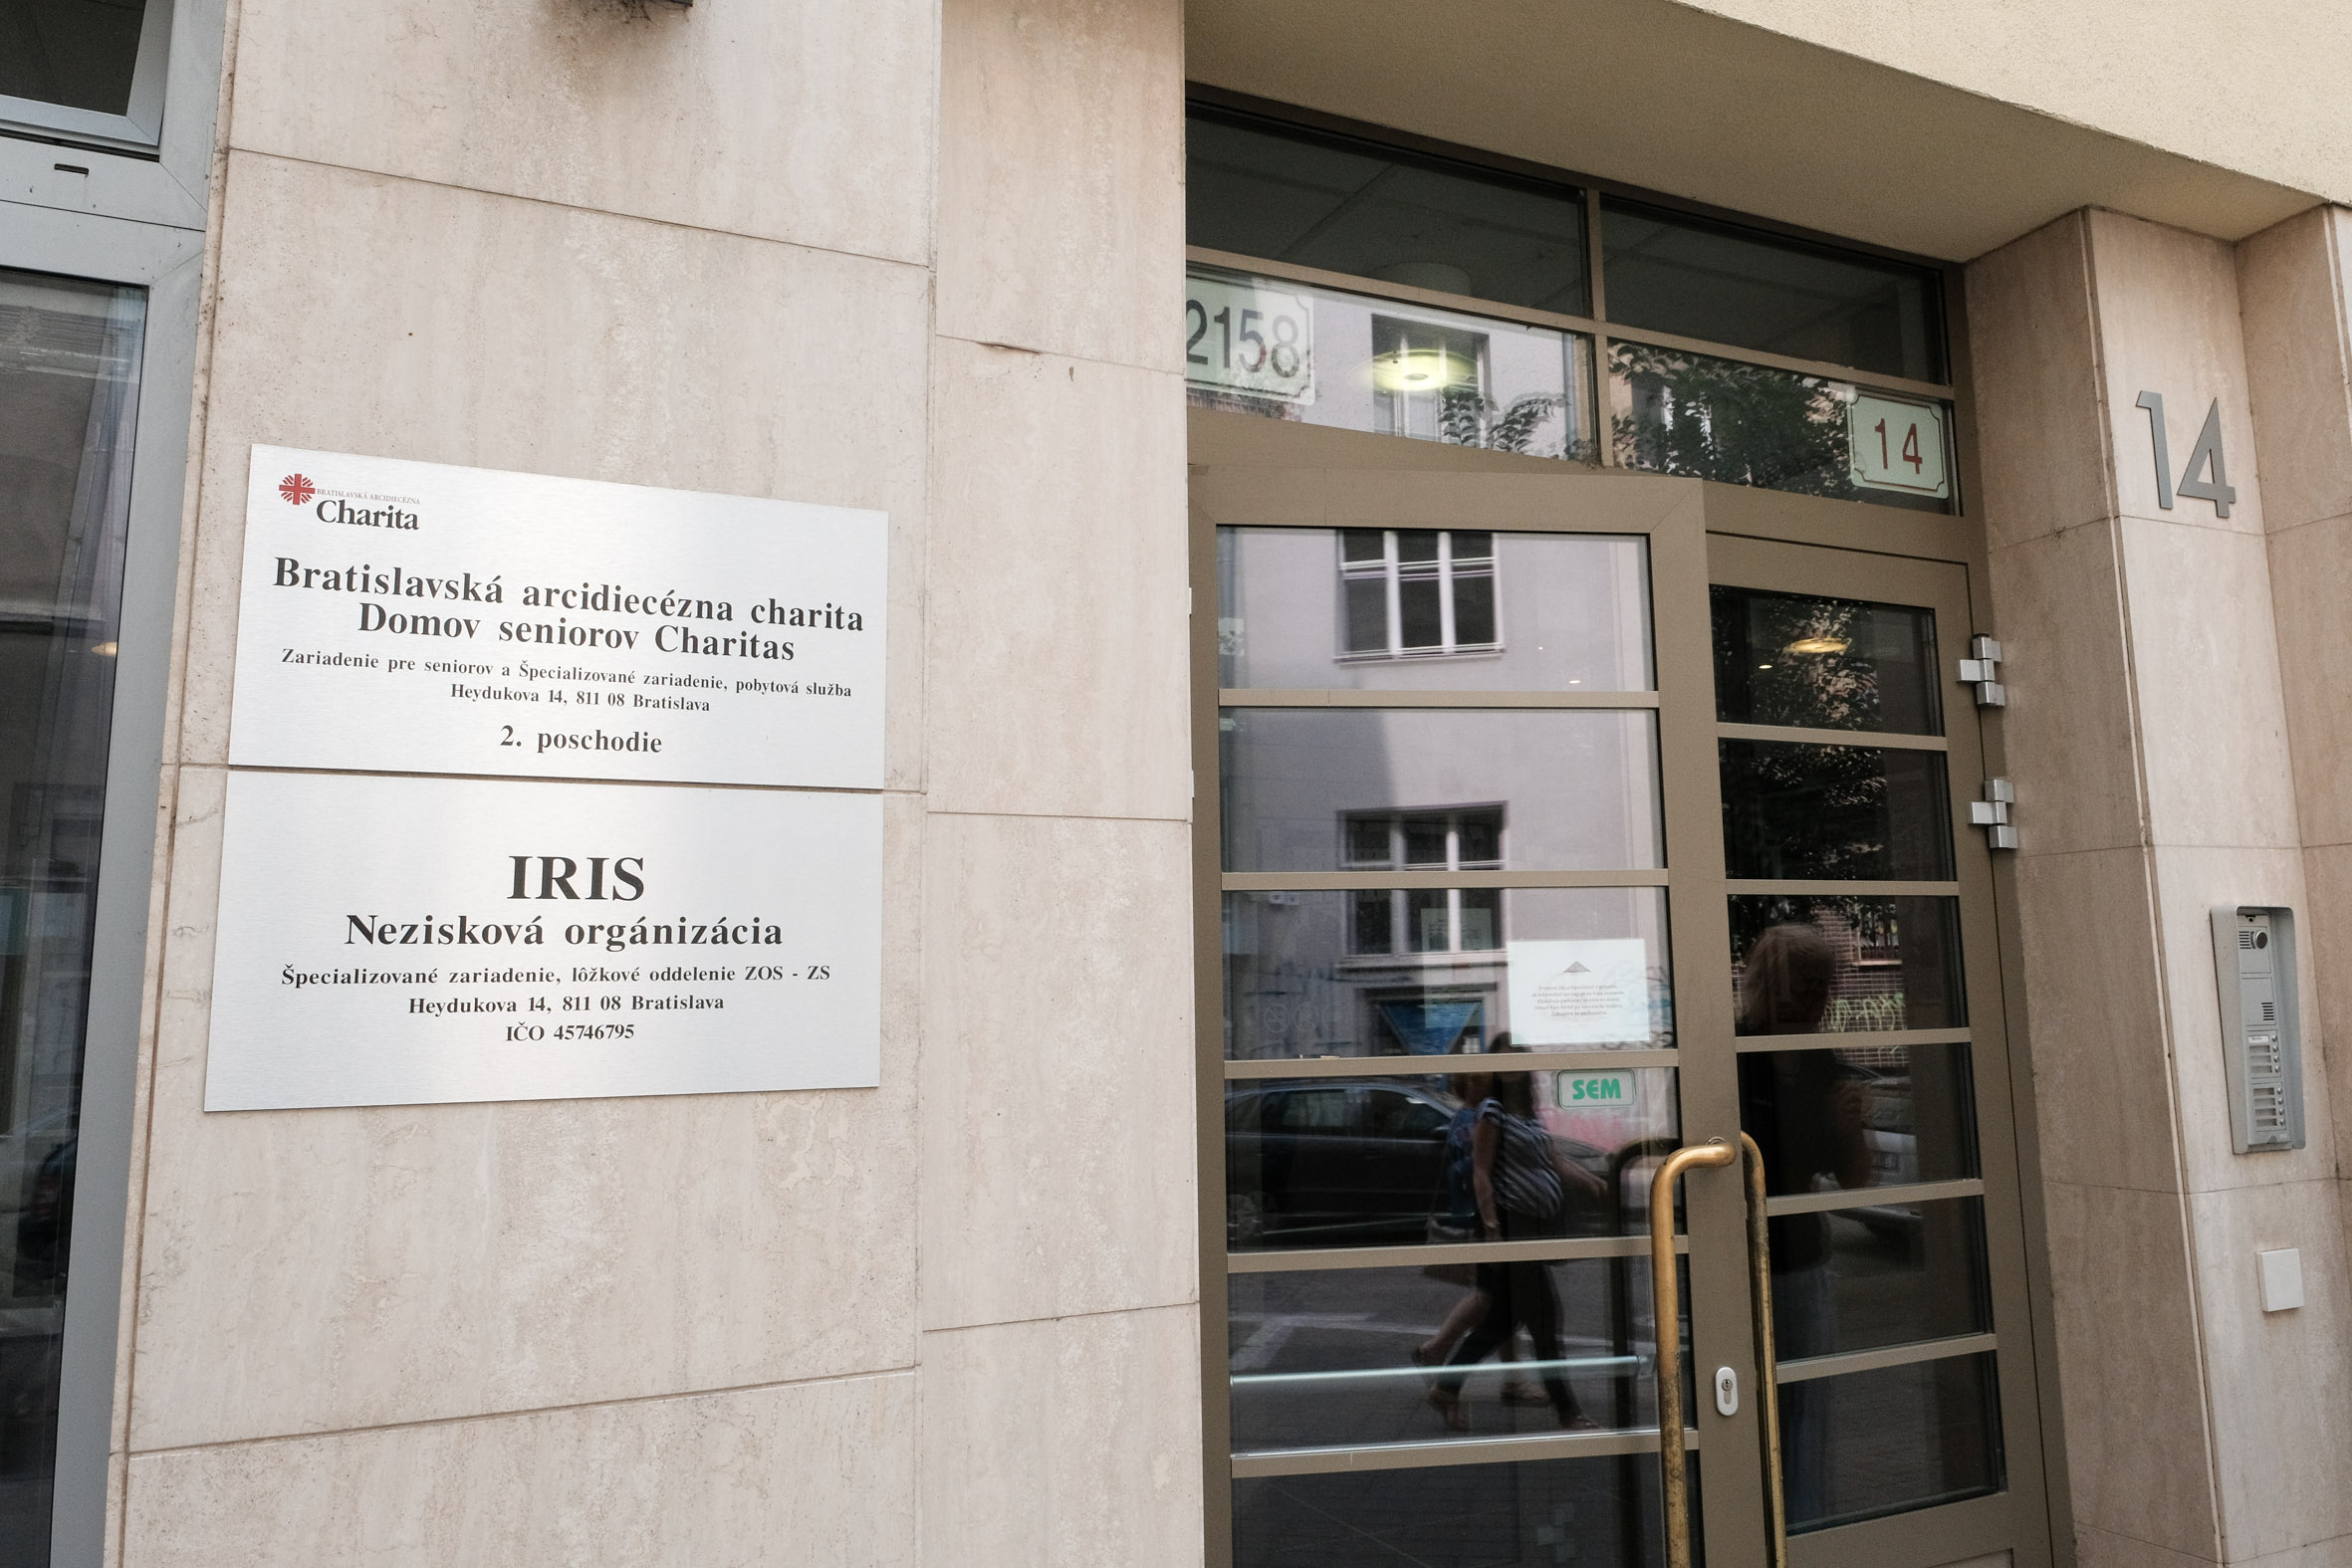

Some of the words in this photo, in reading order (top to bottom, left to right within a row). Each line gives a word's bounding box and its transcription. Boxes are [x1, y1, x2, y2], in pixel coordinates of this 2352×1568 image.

[1186, 299, 1299, 378] 2158
[1875, 417, 1923, 475] 14
[2135, 389, 2236, 519] 14
[317, 500, 419, 530] Charita
[273, 558, 503, 603] Bratislavská
[523, 582, 733, 623] arcidiecézna
[751, 598, 863, 631] charita
[357, 602, 481, 639] Domov
[499, 617, 639, 649] seniorov
[655, 625, 794, 660] Charitas
[282, 649, 378, 668] Zariadenie
[388, 659, 415, 673] pre
[424, 659, 493, 674] seniorov
[502, 667, 510, 676] a
[519, 660, 634, 683] Špecializované
[643, 673, 727, 691] zariadenie,
[736, 679, 799, 695] pobytová
[807, 682, 851, 697] služba
[451, 684, 539, 702] Heydukova
[549, 690, 567, 706] 14,
[577, 691, 598, 705] 811
[607, 693, 624, 707] 08
[633, 694, 709, 711] Bratislava
[500, 725, 522, 747] 2.
[537, 730, 661, 754] poschodie
[507, 856, 644, 901] IRIS
[345, 915, 544, 945] Nezisková
[566, 916, 783, 952] orgánizácia
[282, 964, 437, 989] Špecializované
[449, 968, 561, 985] zariadenie,
[573, 967, 639, 982] lôžkové
[649, 967, 735, 982] oddelenie
[745, 966, 783, 980] ZOS
[808, 966, 829, 980] ZS
[408, 998, 517, 1017] Heydukova
[529, 997, 551, 1013] 14,
[563, 997, 589, 1011] 811
[600, 996, 620, 1010] 08
[631, 995, 724, 1009] Bratislava
[506, 1021, 545, 1041] IČO
[554, 1024, 634, 1039] 45746795
[1572, 1078, 1621, 1099] SEM
